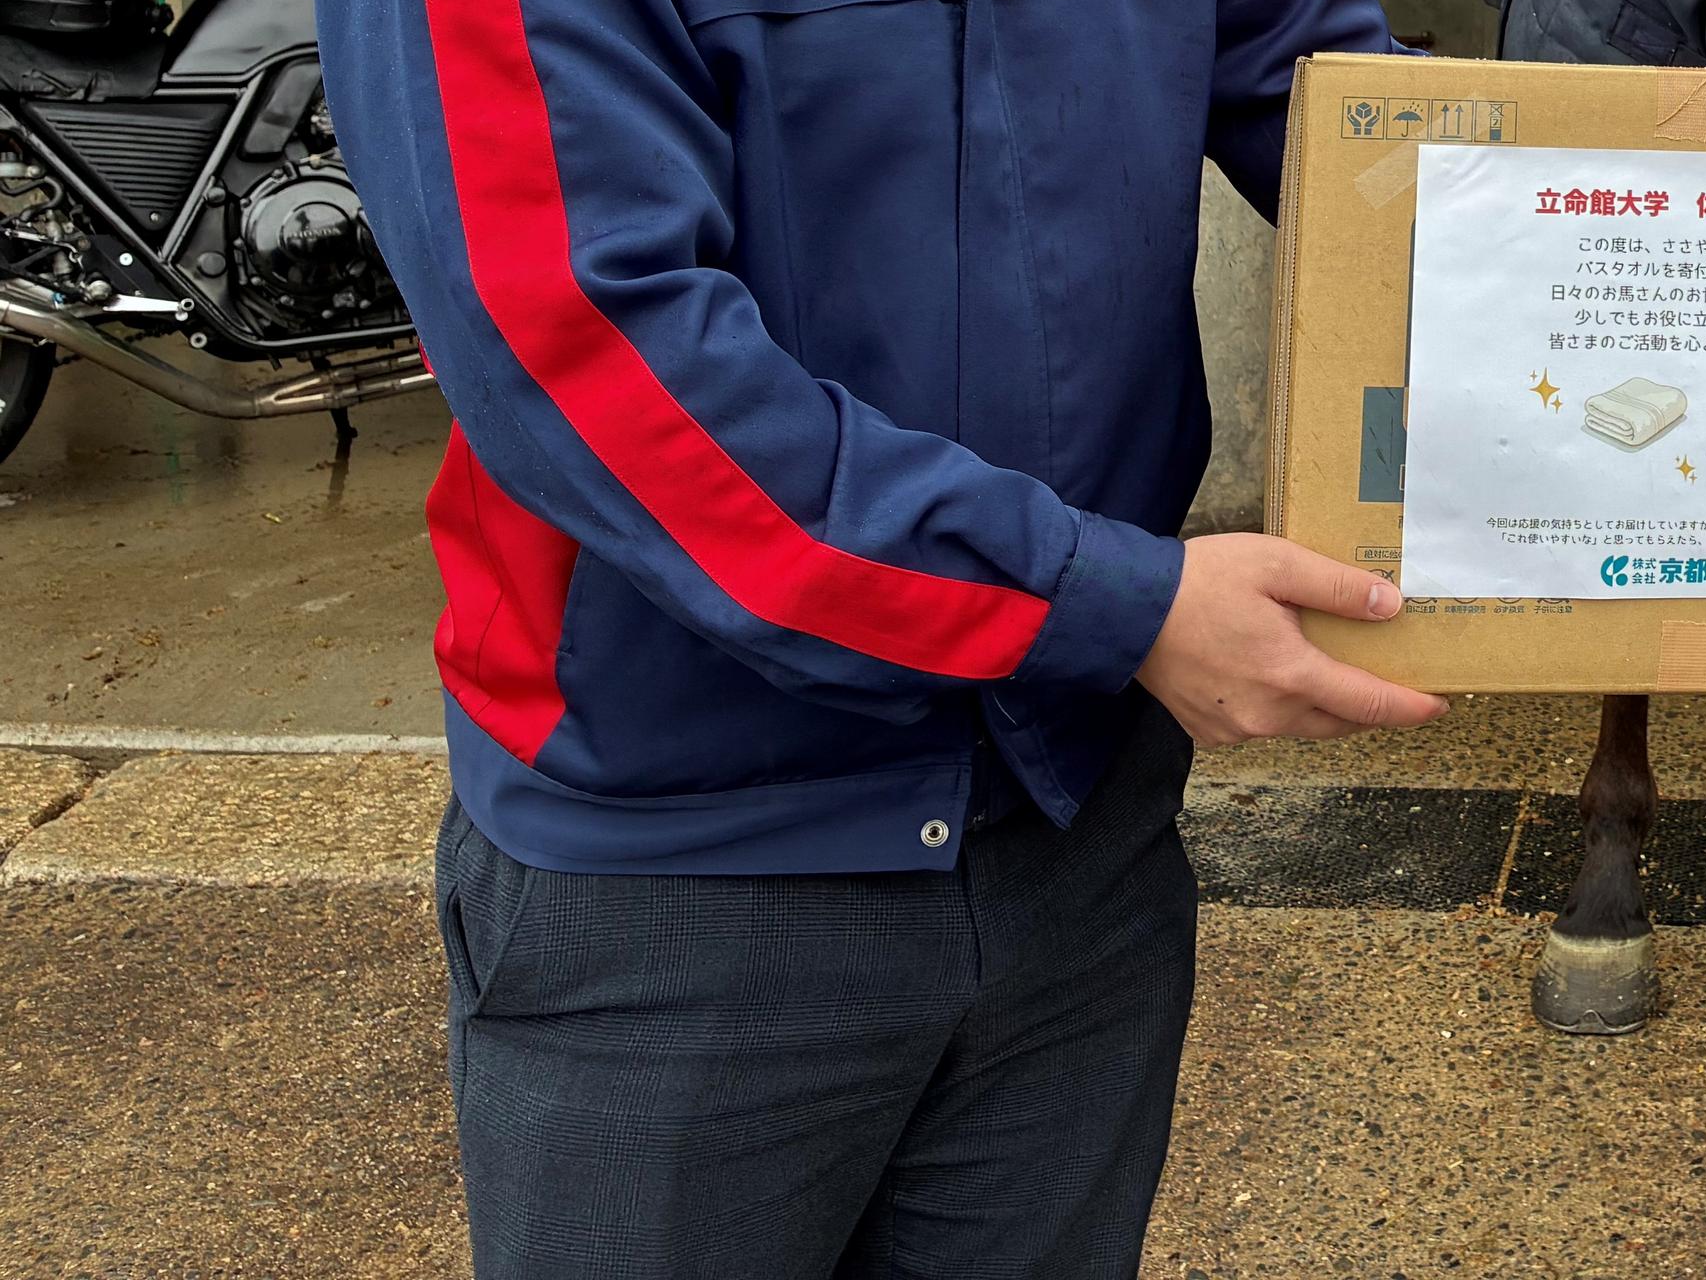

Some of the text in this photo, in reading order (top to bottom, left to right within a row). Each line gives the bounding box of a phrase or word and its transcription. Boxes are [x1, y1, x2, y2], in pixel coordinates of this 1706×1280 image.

[1535, 188, 1670, 218] 立命館大学
[1500, 533, 1703, 546] 「これ使いやすいな」と思ってもらえたら、
[1632, 558, 1656, 570] 株式
[1632, 572, 1656, 584] 会社
